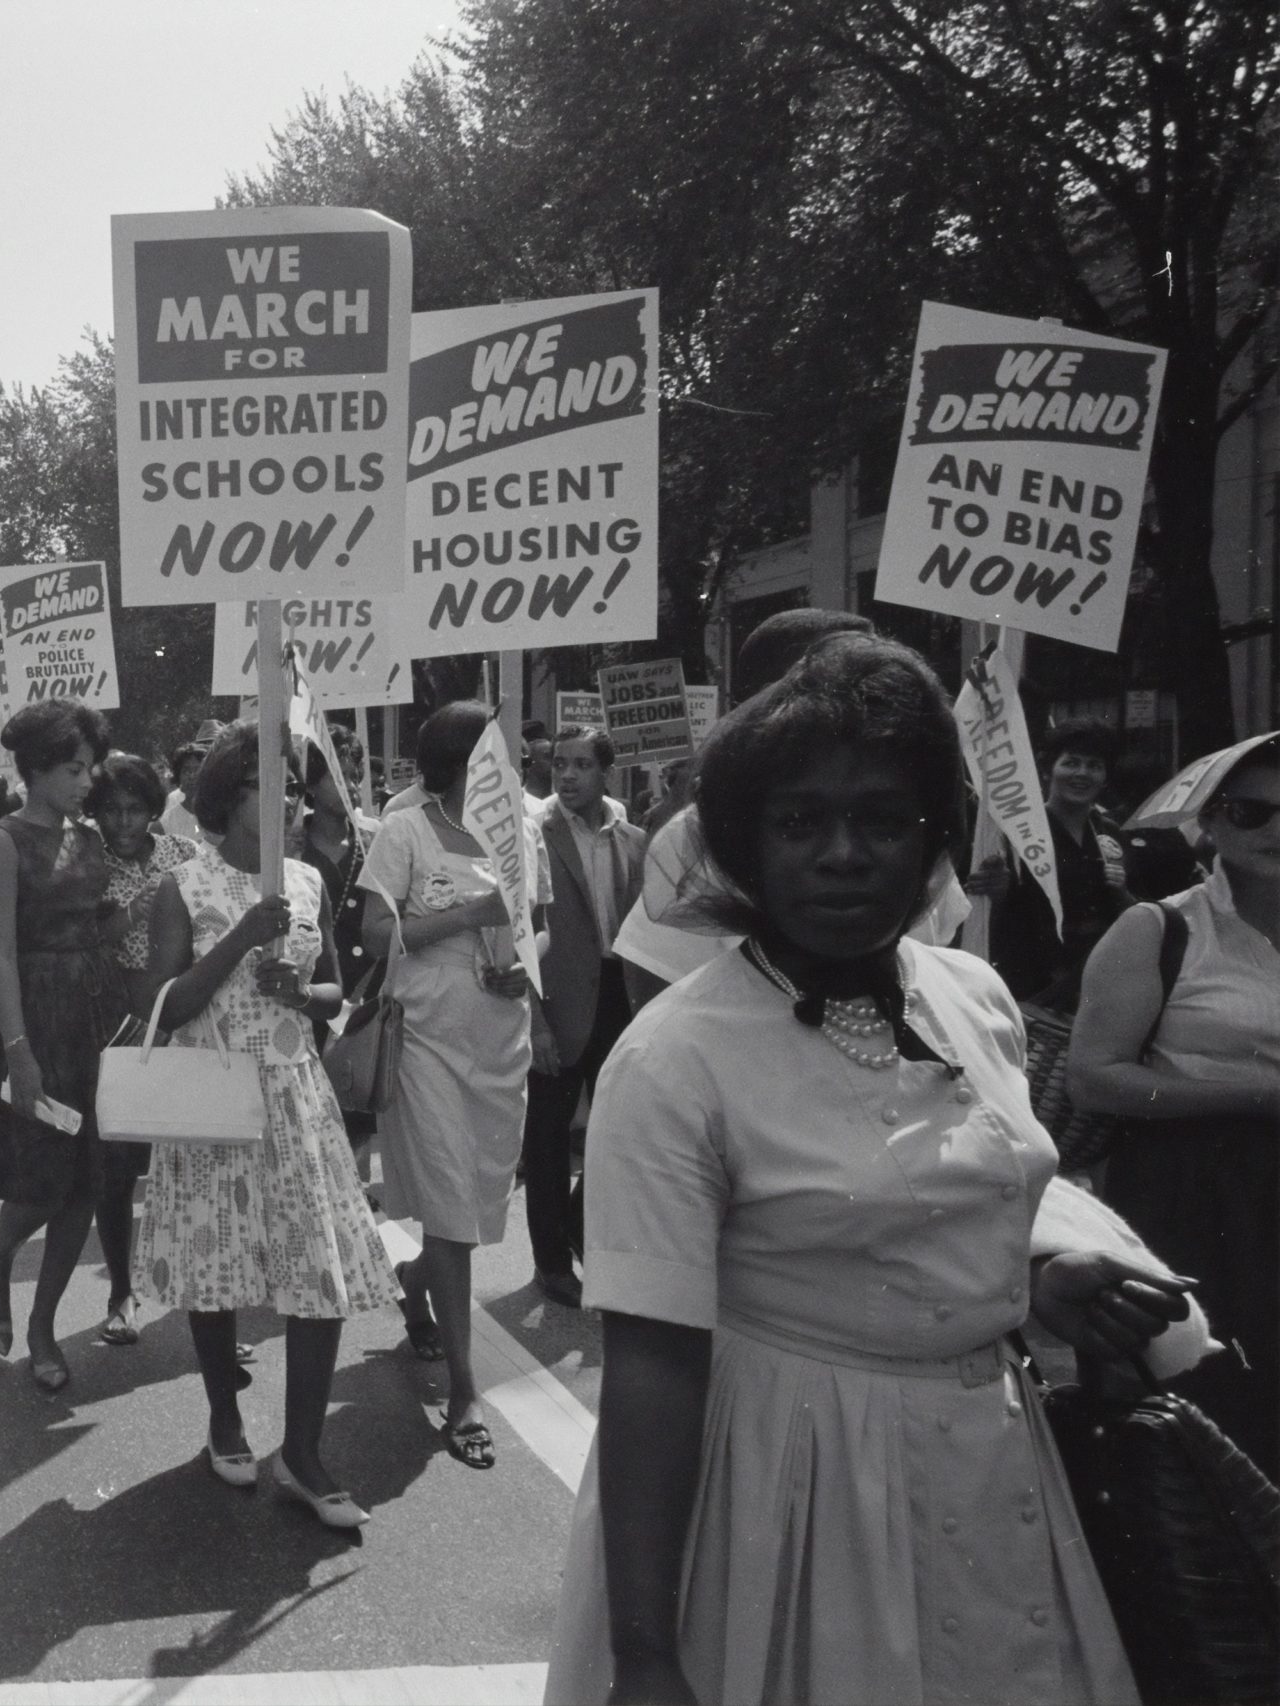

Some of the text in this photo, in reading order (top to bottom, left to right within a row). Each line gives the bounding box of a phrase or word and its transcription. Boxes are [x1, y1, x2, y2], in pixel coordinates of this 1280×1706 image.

[226, 244, 301, 284] WE
[156, 288, 370, 343] MARCH
[223, 346, 306, 371] FOR
[471, 323, 563, 393] WE
[995, 348, 1084, 389] WE
[138, 389, 388, 442] INTEGRATED
[408, 355, 638, 467] DEMAND
[926, 391, 1140, 436] DEMAND
[141, 451, 385, 503] SCHOOLS
[431, 461, 624, 517] DECENT
[926, 452, 1124, 522] AN END
[159, 504, 375, 578] NOW!
[412, 517, 642, 574] HOUSING
[926, 495, 1113, 566] TO BIAS
[34, 570, 71, 598] WE
[428, 556, 631, 631] NOW!
[917, 543, 1108, 616] NOW!
[11, 585, 99, 630] DEMAND
[245, 600, 372, 628] RGHTS
[20, 628, 96, 646] AN END
[38, 648, 85, 664] POLICE
[25, 661, 95, 679] BRUTALITY
[26, 669, 108, 702] NOW!
[607, 665, 673, 683] UAW SAYS
[606, 681, 680, 705] JOBS and
[608, 701, 685, 728] FREEDOM
[641, 735, 688, 751] American
[467, 751, 521, 892] FREEDOM
[1017, 821, 1032, 841] IN
